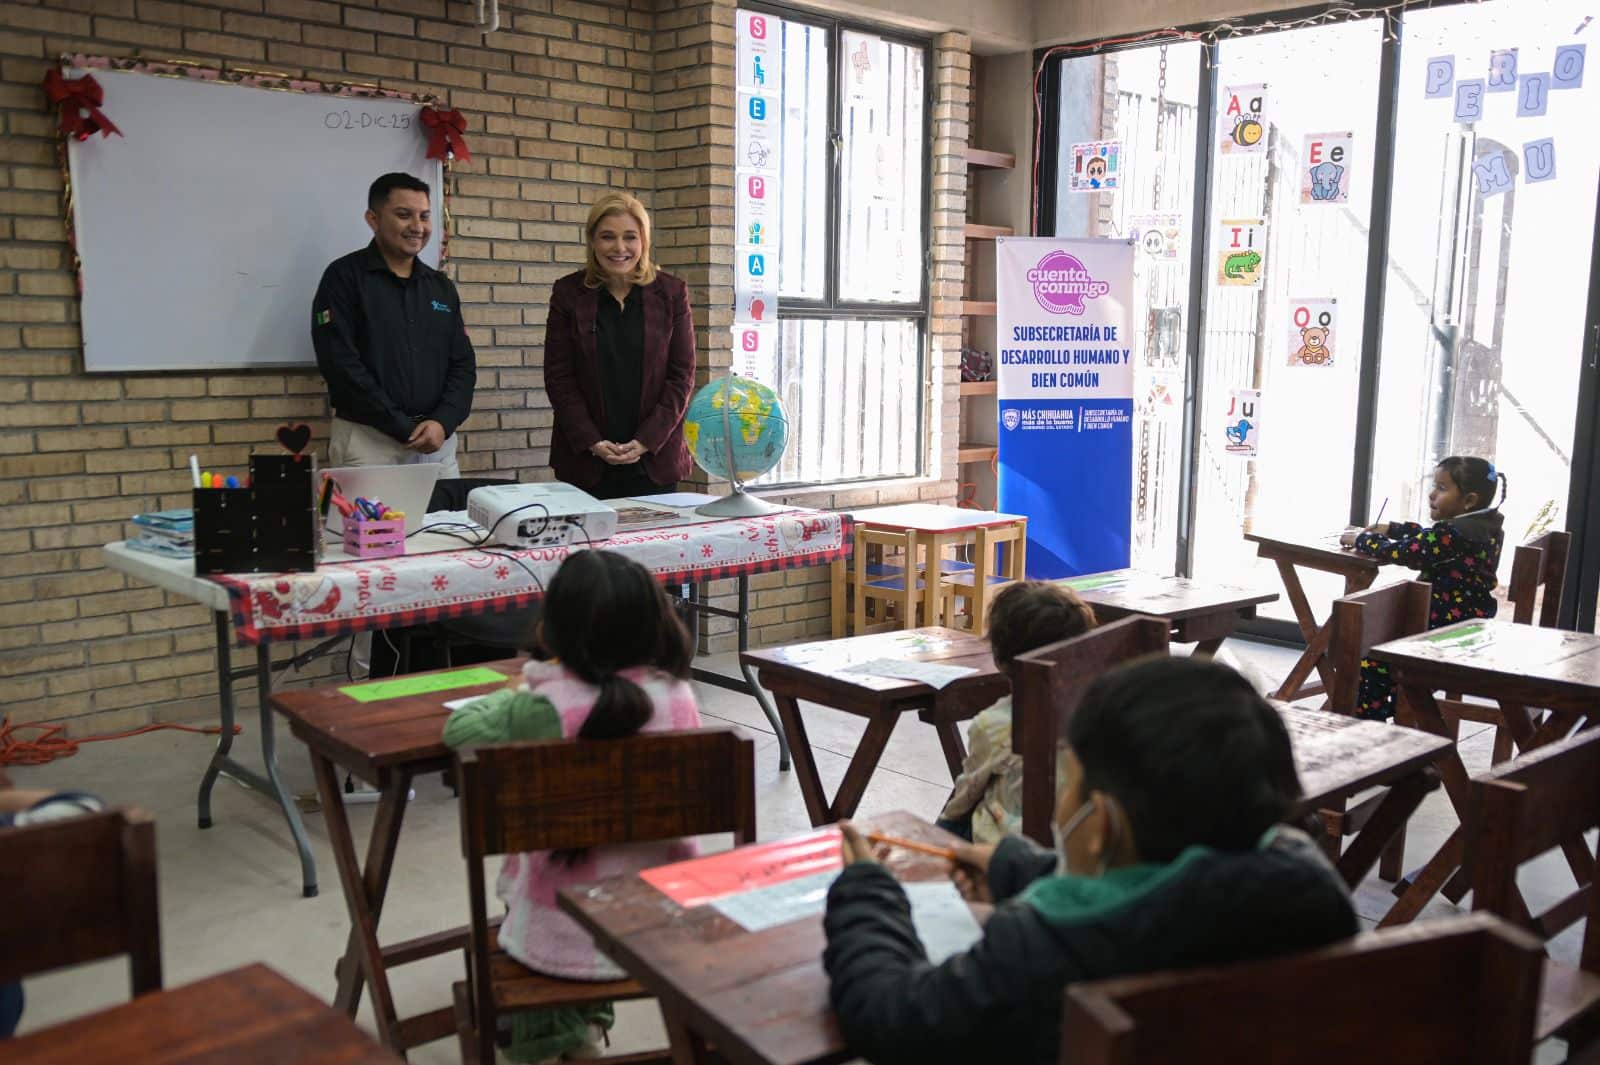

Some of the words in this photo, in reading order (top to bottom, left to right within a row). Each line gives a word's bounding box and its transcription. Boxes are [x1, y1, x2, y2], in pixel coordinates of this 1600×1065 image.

[1028, 267, 1089, 281] cuenta
[1039, 281, 1108, 297] conmigo
[1013, 323, 1101, 341] SUBSECRETARÍA
[1103, 326, 1117, 341] DE
[1001, 349, 1070, 364] DESARROLLO
[1073, 349, 1120, 364] HUMANO
[1122, 349, 1130, 364] Y
[1031, 372, 1057, 387] BIEN
[1060, 369, 1099, 387] COMÚN
[1022, 408, 1036, 420] MÁS
[1037, 409, 1073, 420] CHIHUAHUA
